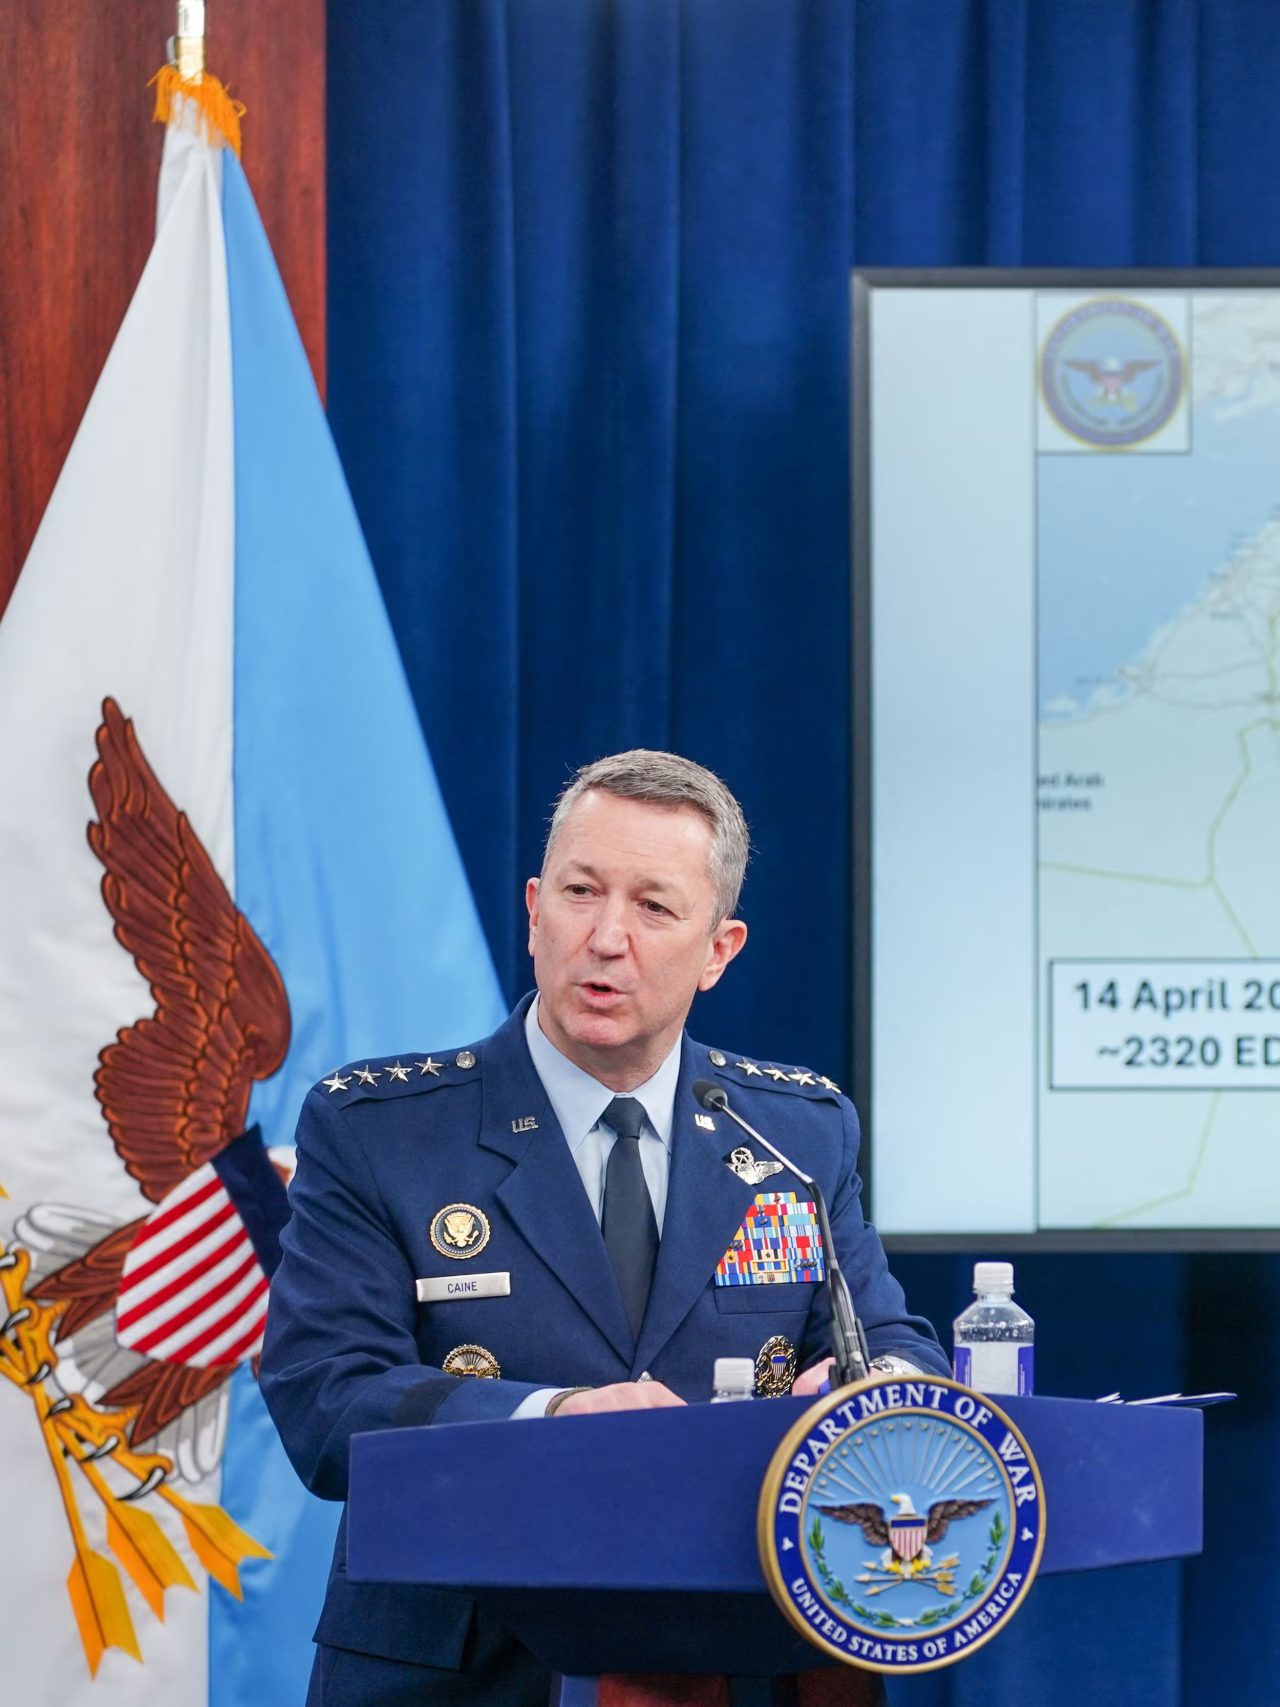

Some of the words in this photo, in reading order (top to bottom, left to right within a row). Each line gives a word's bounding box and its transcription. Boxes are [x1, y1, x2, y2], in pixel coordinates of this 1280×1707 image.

[1065, 772, 1105, 789] Arab
[1074, 979, 1121, 1012] 14
[1131, 977, 1229, 1020] April
[1097, 1035, 1222, 1068] ~2320
[447, 1281, 478, 1293] CAINE
[780, 1383, 949, 1515] DEPARTMENT
[953, 1395, 993, 1429] OF
[997, 1432, 1037, 1507] WAR
[791, 1578, 848, 1643] UNITED
[848, 1636, 919, 1662] STATES
[922, 1637, 949, 1658] OF
[953, 1571, 1023, 1647] AMERICA
